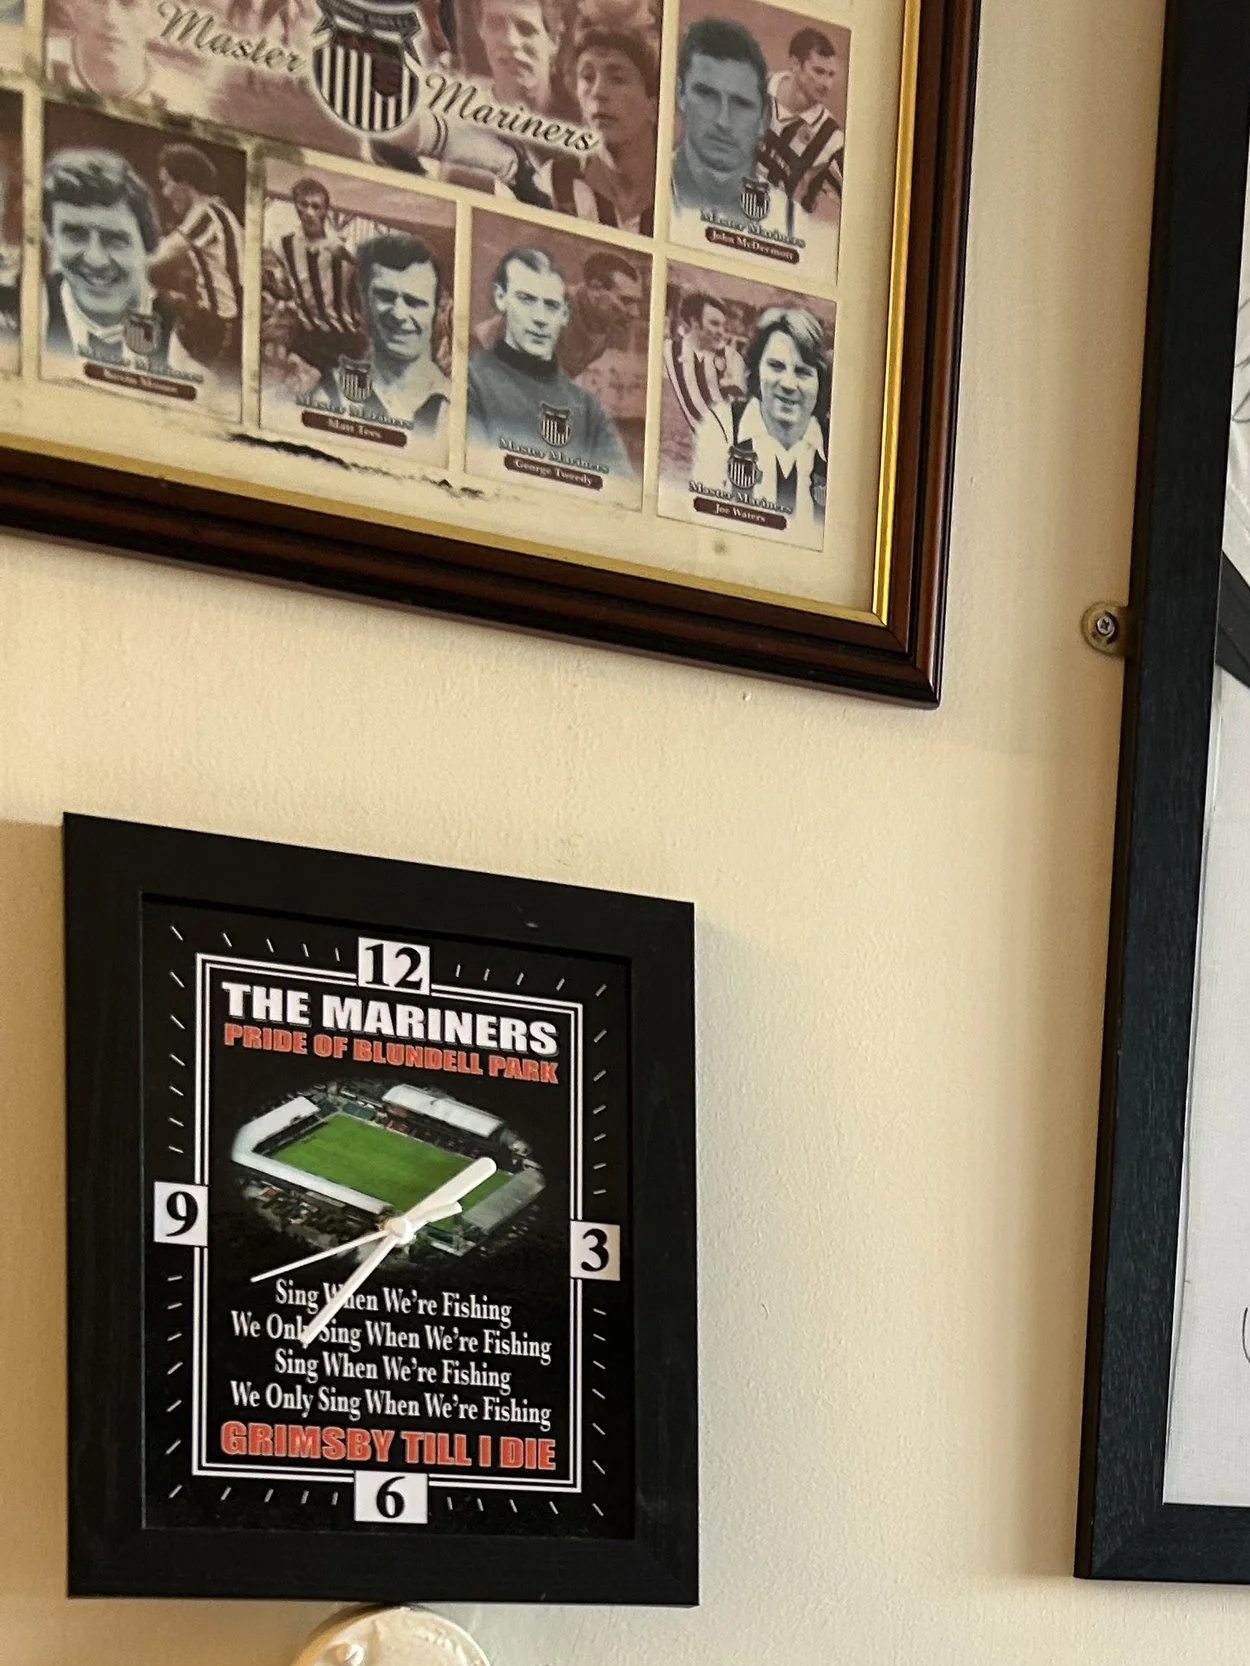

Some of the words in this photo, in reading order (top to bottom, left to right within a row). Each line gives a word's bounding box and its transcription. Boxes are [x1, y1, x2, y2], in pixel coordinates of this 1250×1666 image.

[159, 3, 306, 73] Master
[425, 75, 599, 152] Mariners
[515, 459, 551, 478] George
[554, 468, 593, 487] Tweedy
[713, 502, 731, 516] Joe
[732, 507, 766, 524] Waters
[364, 943, 423, 991] 12
[221, 981, 311, 1026] THE
[322, 994, 559, 1056] MARINERS
[224, 1023, 307, 1054] PRIDE
[314, 1034, 348, 1059] OF
[353, 1039, 483, 1075] BLUNDELL
[489, 1055, 559, 1084] PARK
[164, 1192, 199, 1237] 9
[581, 1228, 610, 1272] 3
[275, 1279, 319, 1315] Sing
[382, 1287, 437, 1316] We're
[442, 1291, 511, 1329] Fishing
[231, 1310, 261, 1338] We
[365, 1320, 420, 1349] When
[425, 1325, 478, 1352] We're
[483, 1329, 551, 1365] Fishing
[274, 1348, 319, 1383] Sing
[323, 1352, 378, 1380] When
[382, 1356, 437, 1383] We're
[442, 1360, 511, 1395] Fishing
[230, 1380, 261, 1407] We
[266, 1383, 313, 1417] Only
[318, 1387, 361, 1421] Sing
[365, 1389, 420, 1417] When
[425, 1393, 478, 1420] We're
[483, 1397, 551, 1431] Fishing
[221, 1421, 394, 1462] GRIMSBY
[401, 1431, 471, 1466] TILL
[479, 1435, 491, 1467] I
[500, 1436, 556, 1470] DIE
[375, 1476, 406, 1520] 6
